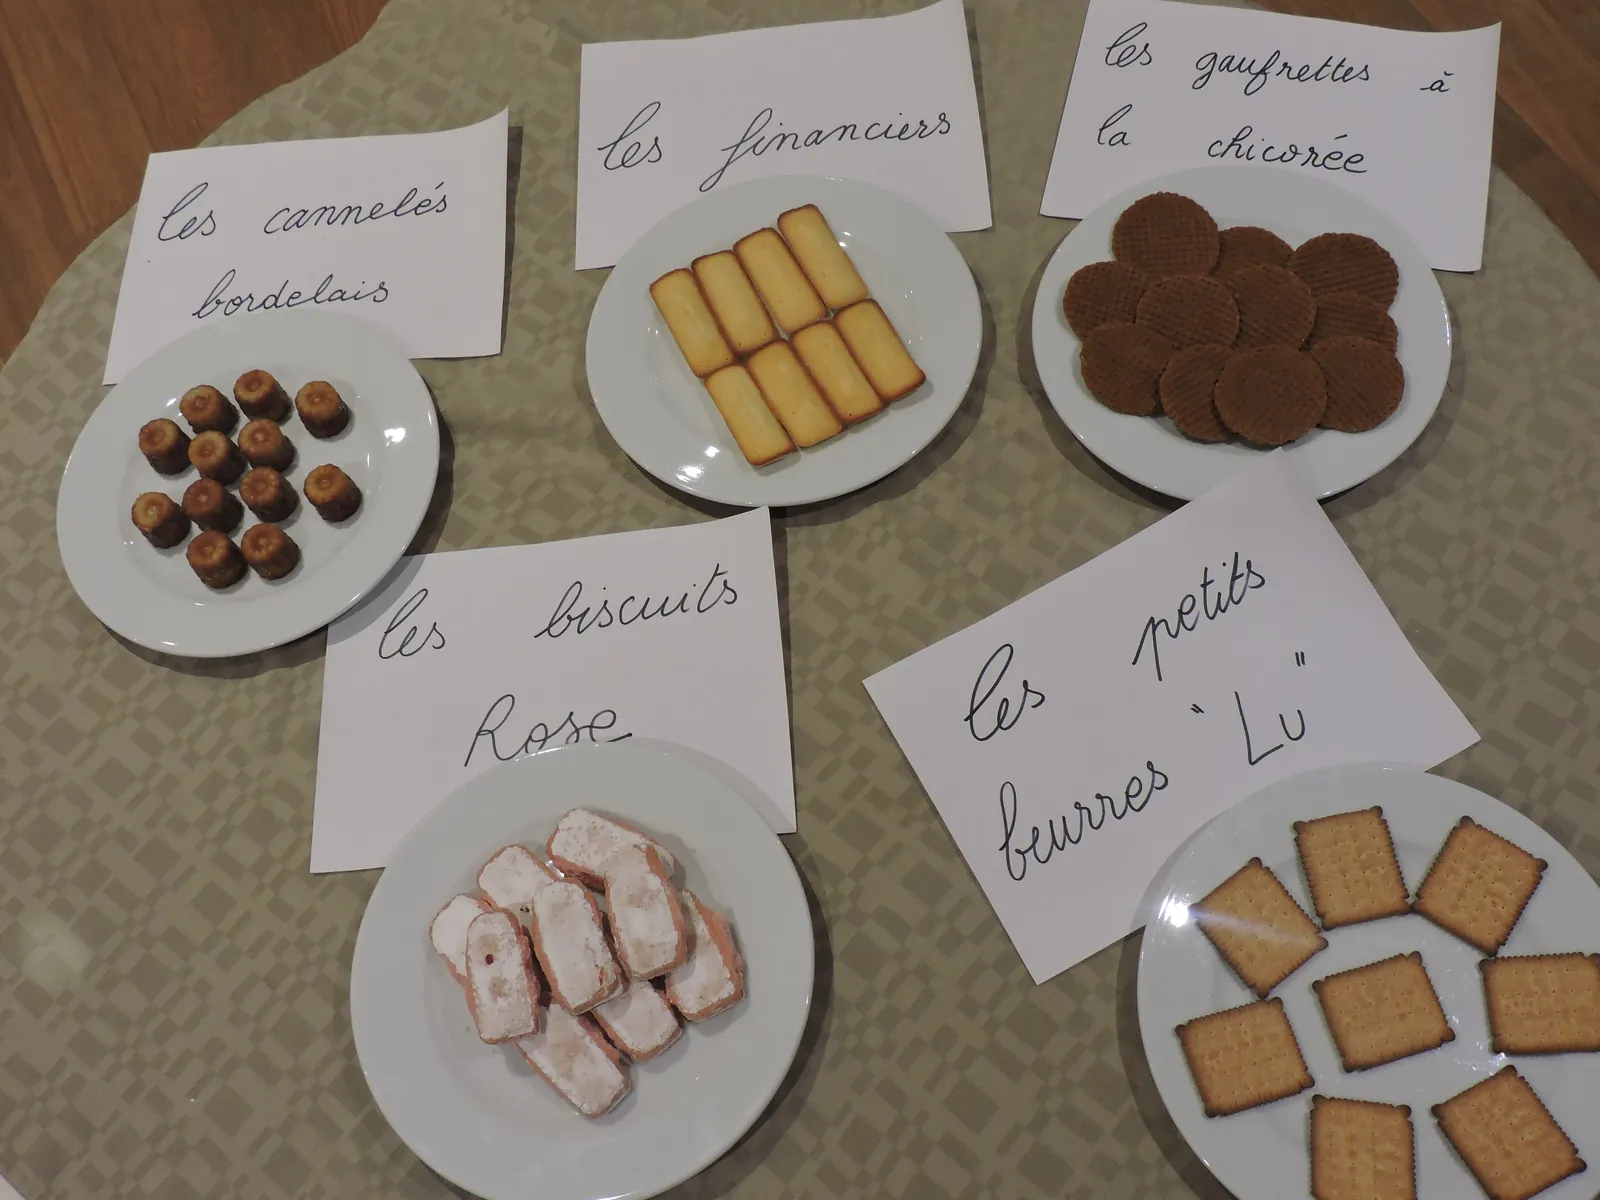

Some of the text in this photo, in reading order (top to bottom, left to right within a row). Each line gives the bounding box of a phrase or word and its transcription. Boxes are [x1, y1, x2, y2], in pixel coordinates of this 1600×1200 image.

[1104, 21, 1153, 68] les
[1191, 49, 1370, 97] gaufrettes
[597, 100, 951, 193] les financiers
[1096, 103, 1368, 174] la chicorée
[157, 180, 448, 242] les cannelés
[191, 268, 389, 320] bordelais
[377, 562, 738, 660] les biscuits
[963, 551, 1266, 742] les petits
[463, 693, 634, 768] Rose
[998, 760, 1169, 882] beurres
